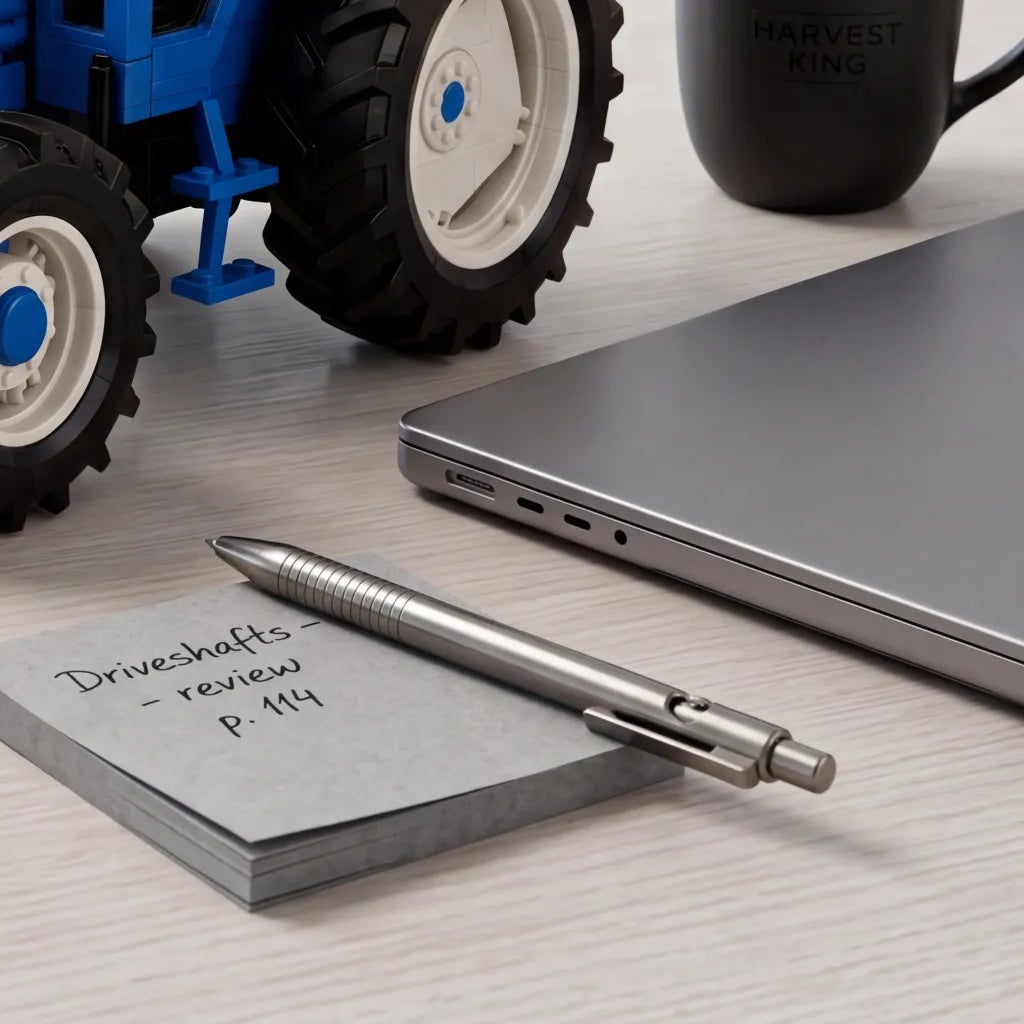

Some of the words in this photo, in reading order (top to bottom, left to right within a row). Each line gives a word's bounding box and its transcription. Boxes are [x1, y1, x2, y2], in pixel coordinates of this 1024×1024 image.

[753, 19, 903, 46] HARVEST
[788, 52, 866, 75] KING
[54, 624, 291, 693] Driveshafts
[176, 657, 302, 702] review
[263, 688, 324, 716] 114
